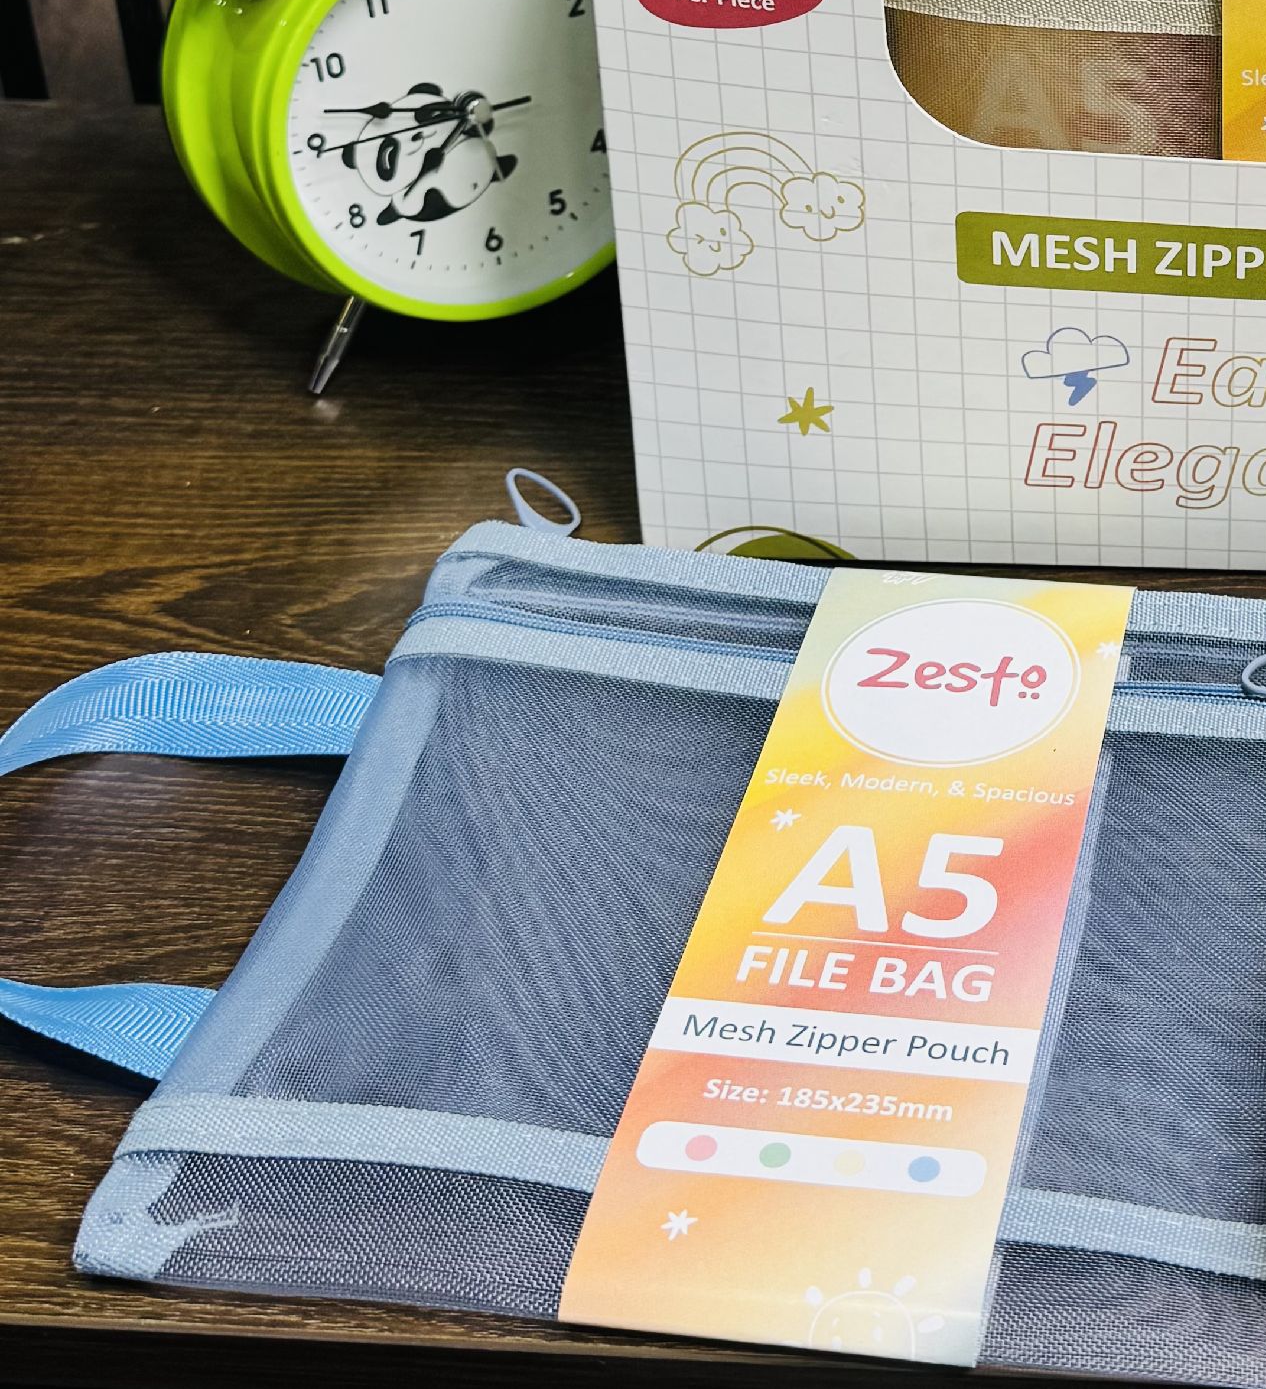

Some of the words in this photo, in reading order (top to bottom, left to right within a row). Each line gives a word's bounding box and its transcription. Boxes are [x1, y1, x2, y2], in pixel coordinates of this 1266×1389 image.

[310, 53, 345, 82] 10
[349, 204, 366, 228] 8
[550, 190, 567, 215] 5
[410, 229, 425, 255] 7
[485, 227, 503, 252] 6
[991, 230, 1138, 275] MESH
[856, 647, 1048, 707] Zesto
[765, 767, 833, 790] Sleek,
[841, 772, 939, 798] Modern,
[948, 779, 966, 797] &
[973, 781, 1075, 807] Spacious
[762, 825, 1004, 939] A5
[736, 944, 855, 990] FILE
[869, 957, 995, 1003] BAG
[683, 1013, 775, 1045] Mesh
[786, 1024, 897, 1056] Zipper
[906, 1035, 1010, 1066] Pouch
[703, 1078, 769, 1104] Size:
[776, 1086, 953, 1123] 185x235mm
